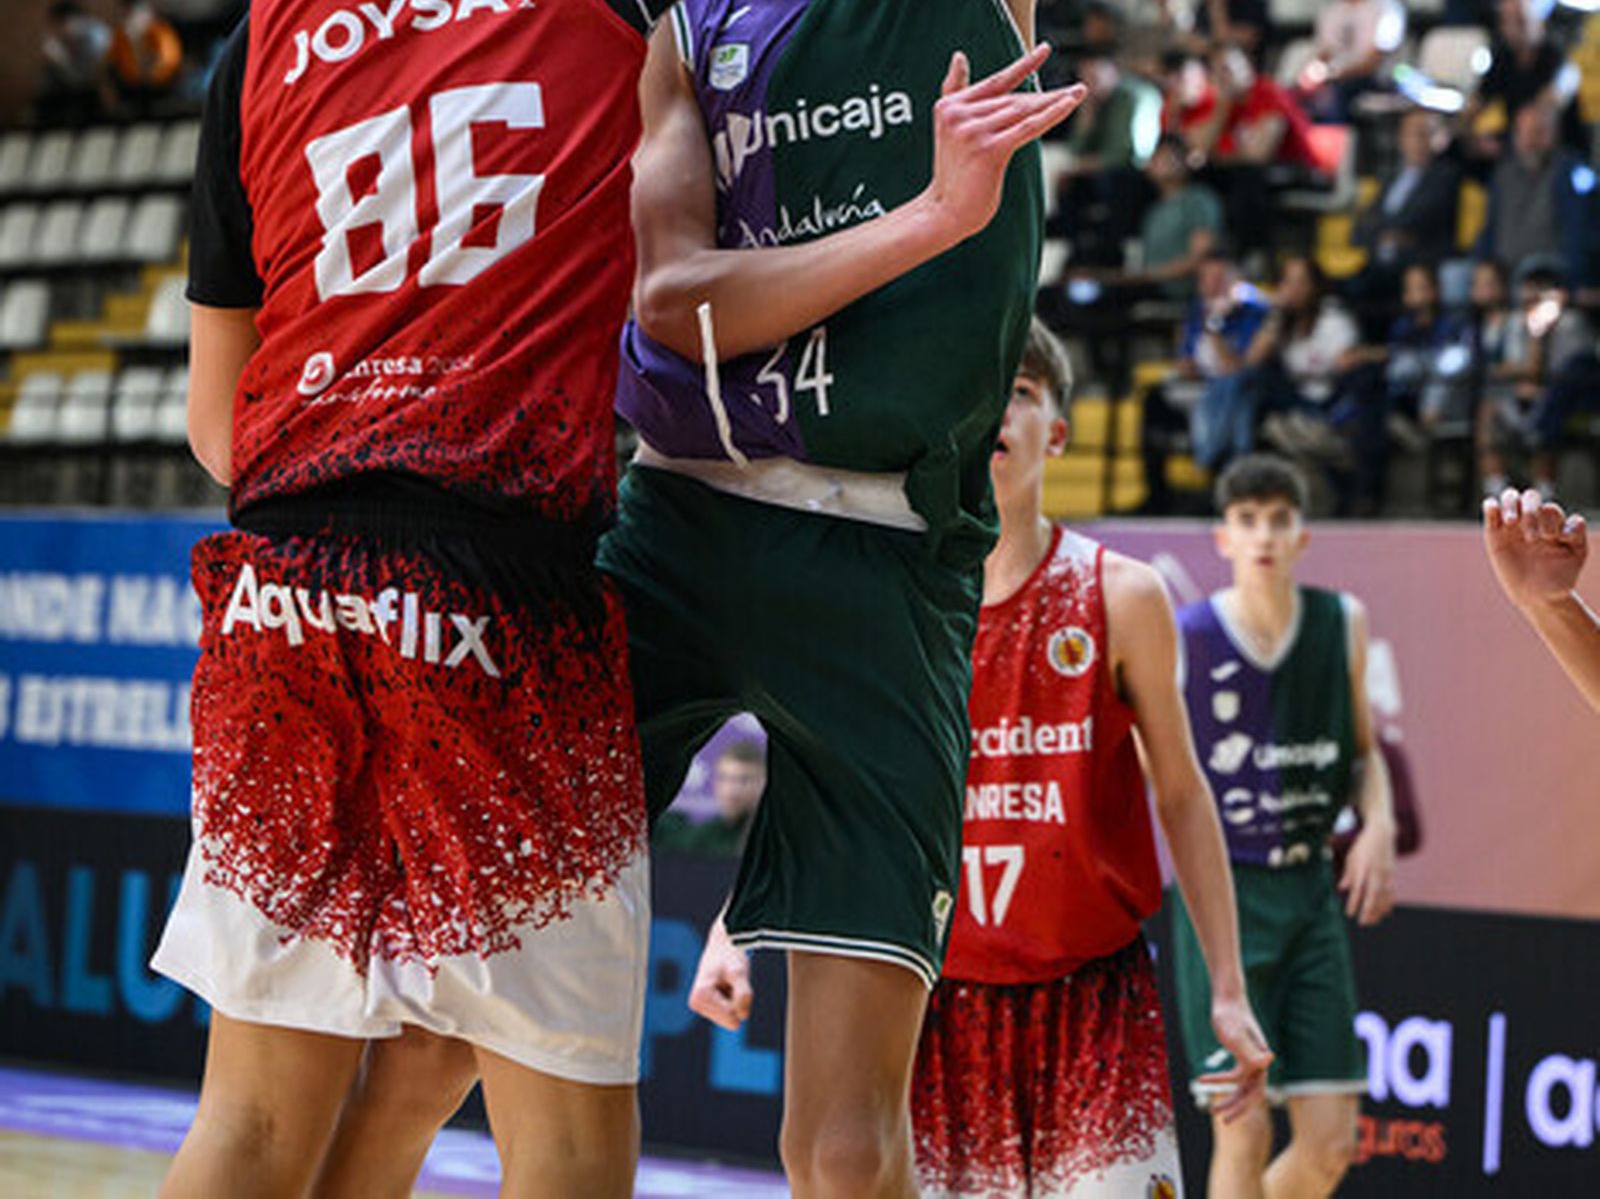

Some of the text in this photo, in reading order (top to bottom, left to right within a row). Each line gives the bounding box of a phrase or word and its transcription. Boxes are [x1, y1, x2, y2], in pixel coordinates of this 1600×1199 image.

[744, 83, 914, 157] Unicaja
[304, 82, 545, 301] 86
[220, 563, 500, 678] Aquaflix
[970, 715, 1093, 758] cident
[963, 781, 1066, 826] NRESA
[962, 844, 1025, 928] 17
